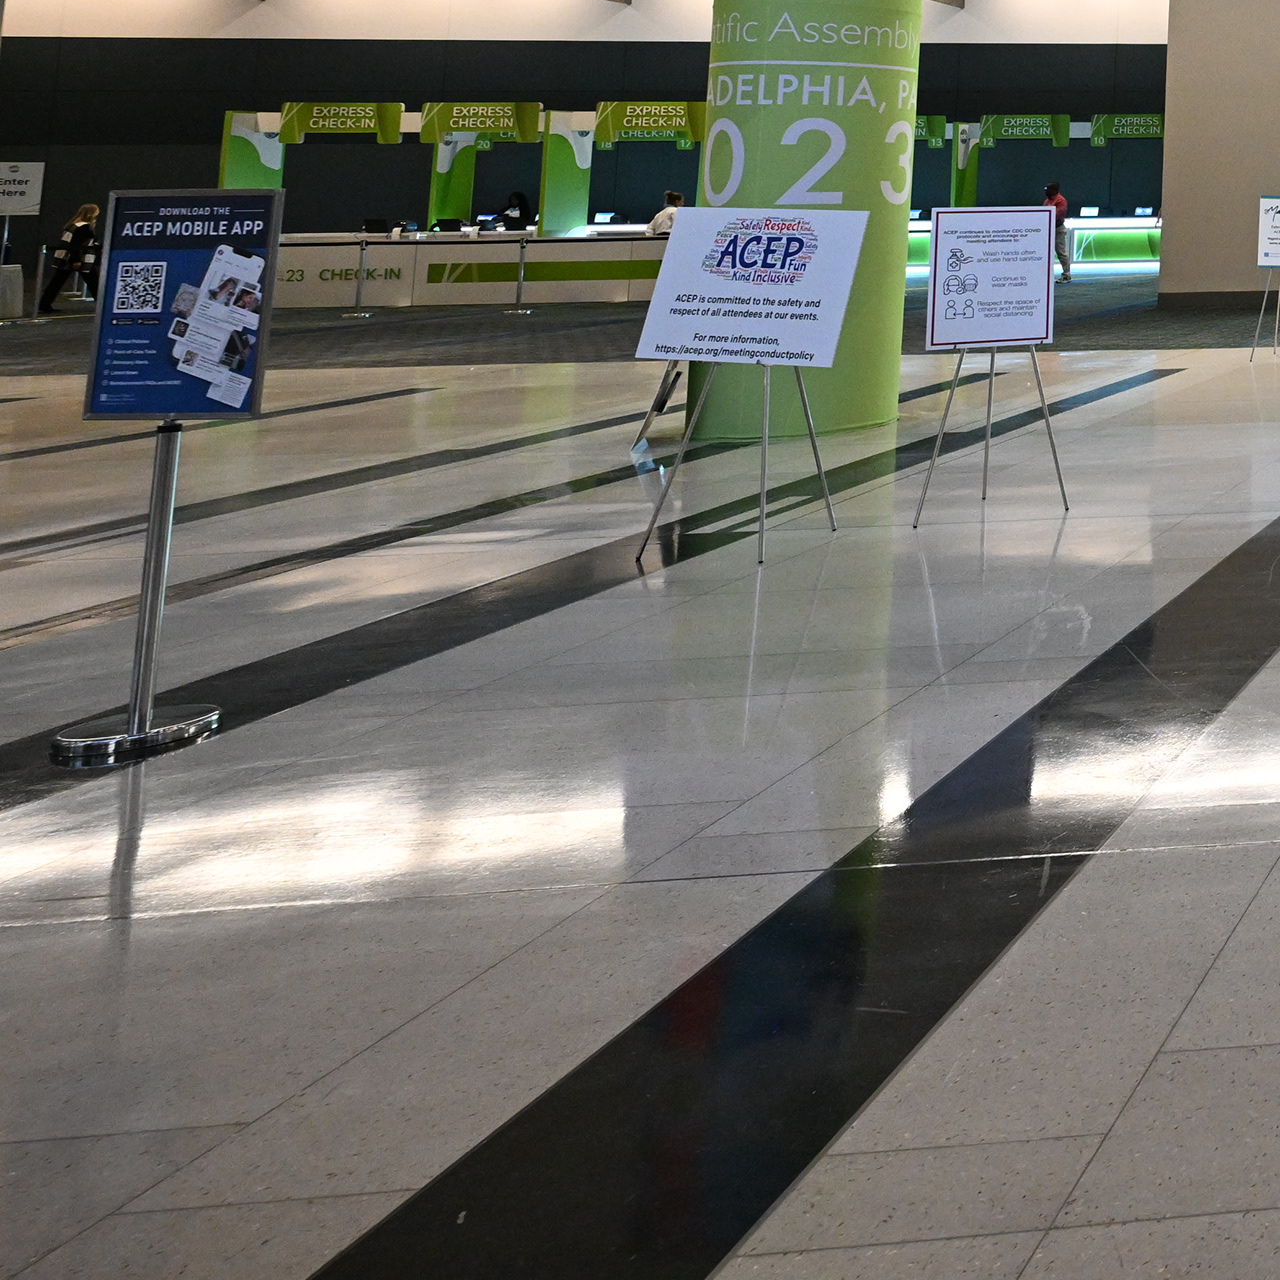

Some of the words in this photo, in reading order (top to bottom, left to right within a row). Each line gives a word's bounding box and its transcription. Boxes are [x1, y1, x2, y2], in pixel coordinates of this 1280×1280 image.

[768, 12, 918, 58] Assembly
[313, 107, 374, 117] EXPRESS
[453, 106, 512, 116] EXPRESS
[627, 106, 684, 115] EXPRESS
[309, 118, 375, 128] CHECK-IN
[450, 118, 514, 128] CHECK-IN
[623, 117, 685, 126] CHECK-IN
[1004, 118, 1049, 126] EXPRESS
[1114, 117, 1159, 125] EXPRESS
[1002, 127, 1051, 135] CHECK-IN
[1113, 126, 1160, 134] CHECK-IN
[477, 141, 490, 149] 20
[932, 139, 942, 147] 13
[983, 138, 993, 146] 12
[1094, 137, 1104, 145] 10
[0, 178, 30, 186] Enter
[0, 189, 26, 197] Here
[159, 208, 210, 216] DOWNLOAD
[213, 207, 230, 215] THE
[121, 222, 163, 236] ACEP
[166, 221, 228, 236] MOBILE
[231, 221, 263, 235] APP
[740, 221, 763, 233] Safety
[764, 219, 801, 234] Respect
[716, 235, 805, 269] ACEP
[788, 259, 806, 271] Fun
[286, 269, 304, 282] 23
[319, 268, 401, 280] CHECK-IN
[732, 271, 751, 282] Kind
[752, 272, 796, 284] Inclusive
[675, 294, 698, 303] ACEP
[698, 295, 705, 303] is
[707, 295, 751, 305] committed
[752, 297, 761, 305] to
[763, 298, 775, 306] the
[777, 298, 803, 308] safety
[804, 299, 821, 308] and
[669, 308, 700, 317] respect
[701, 309, 710, 317] of
[711, 309, 721, 317] all
[722, 309, 763, 318] attendees
[764, 312, 773, 320] at
[775, 313, 788, 321] our
[790, 313, 819, 321] events.
[693, 333, 707, 342] For
[708, 336, 729, 344] more
[730, 335, 780, 346] information,
[655, 344, 814, 361] https://acep.org/meetingconductpolicy
